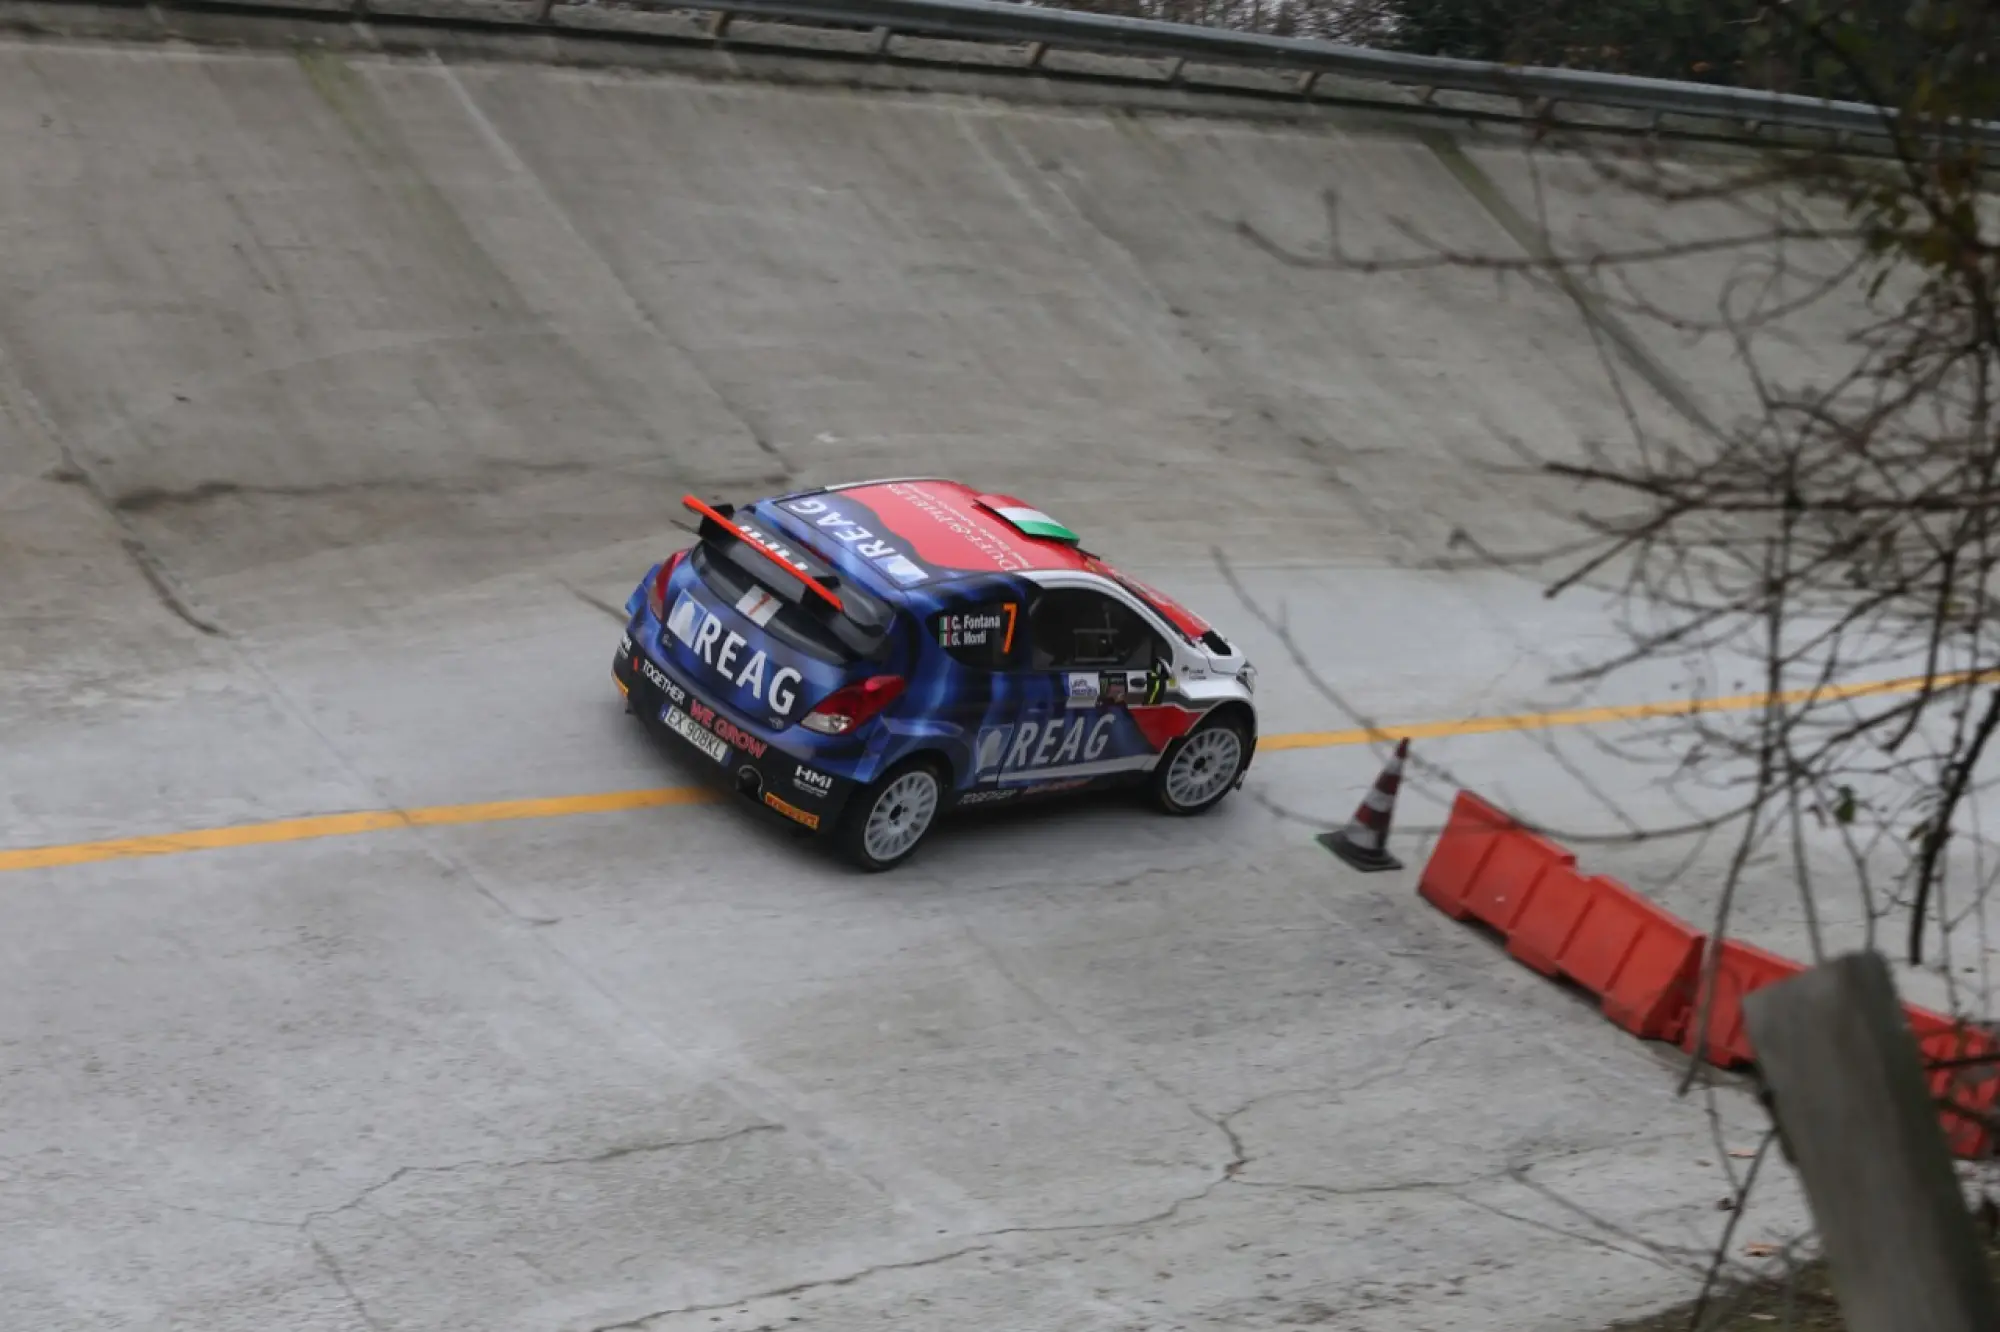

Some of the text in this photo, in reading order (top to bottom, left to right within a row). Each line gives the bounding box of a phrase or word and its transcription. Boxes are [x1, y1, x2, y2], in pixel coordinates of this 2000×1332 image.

[788, 500, 897, 557] REAG
[951, 613, 1001, 630] C. Fontana
[963, 630, 987, 645] Monti
[1002, 602, 1018, 655] 7
[693, 612, 802, 716] REAG
[642, 658, 768, 759] TOGETHER WE GROW
[668, 705, 686, 731] EX
[1003, 713, 1117, 768] REAG
[794, 764, 834, 789] HMI
